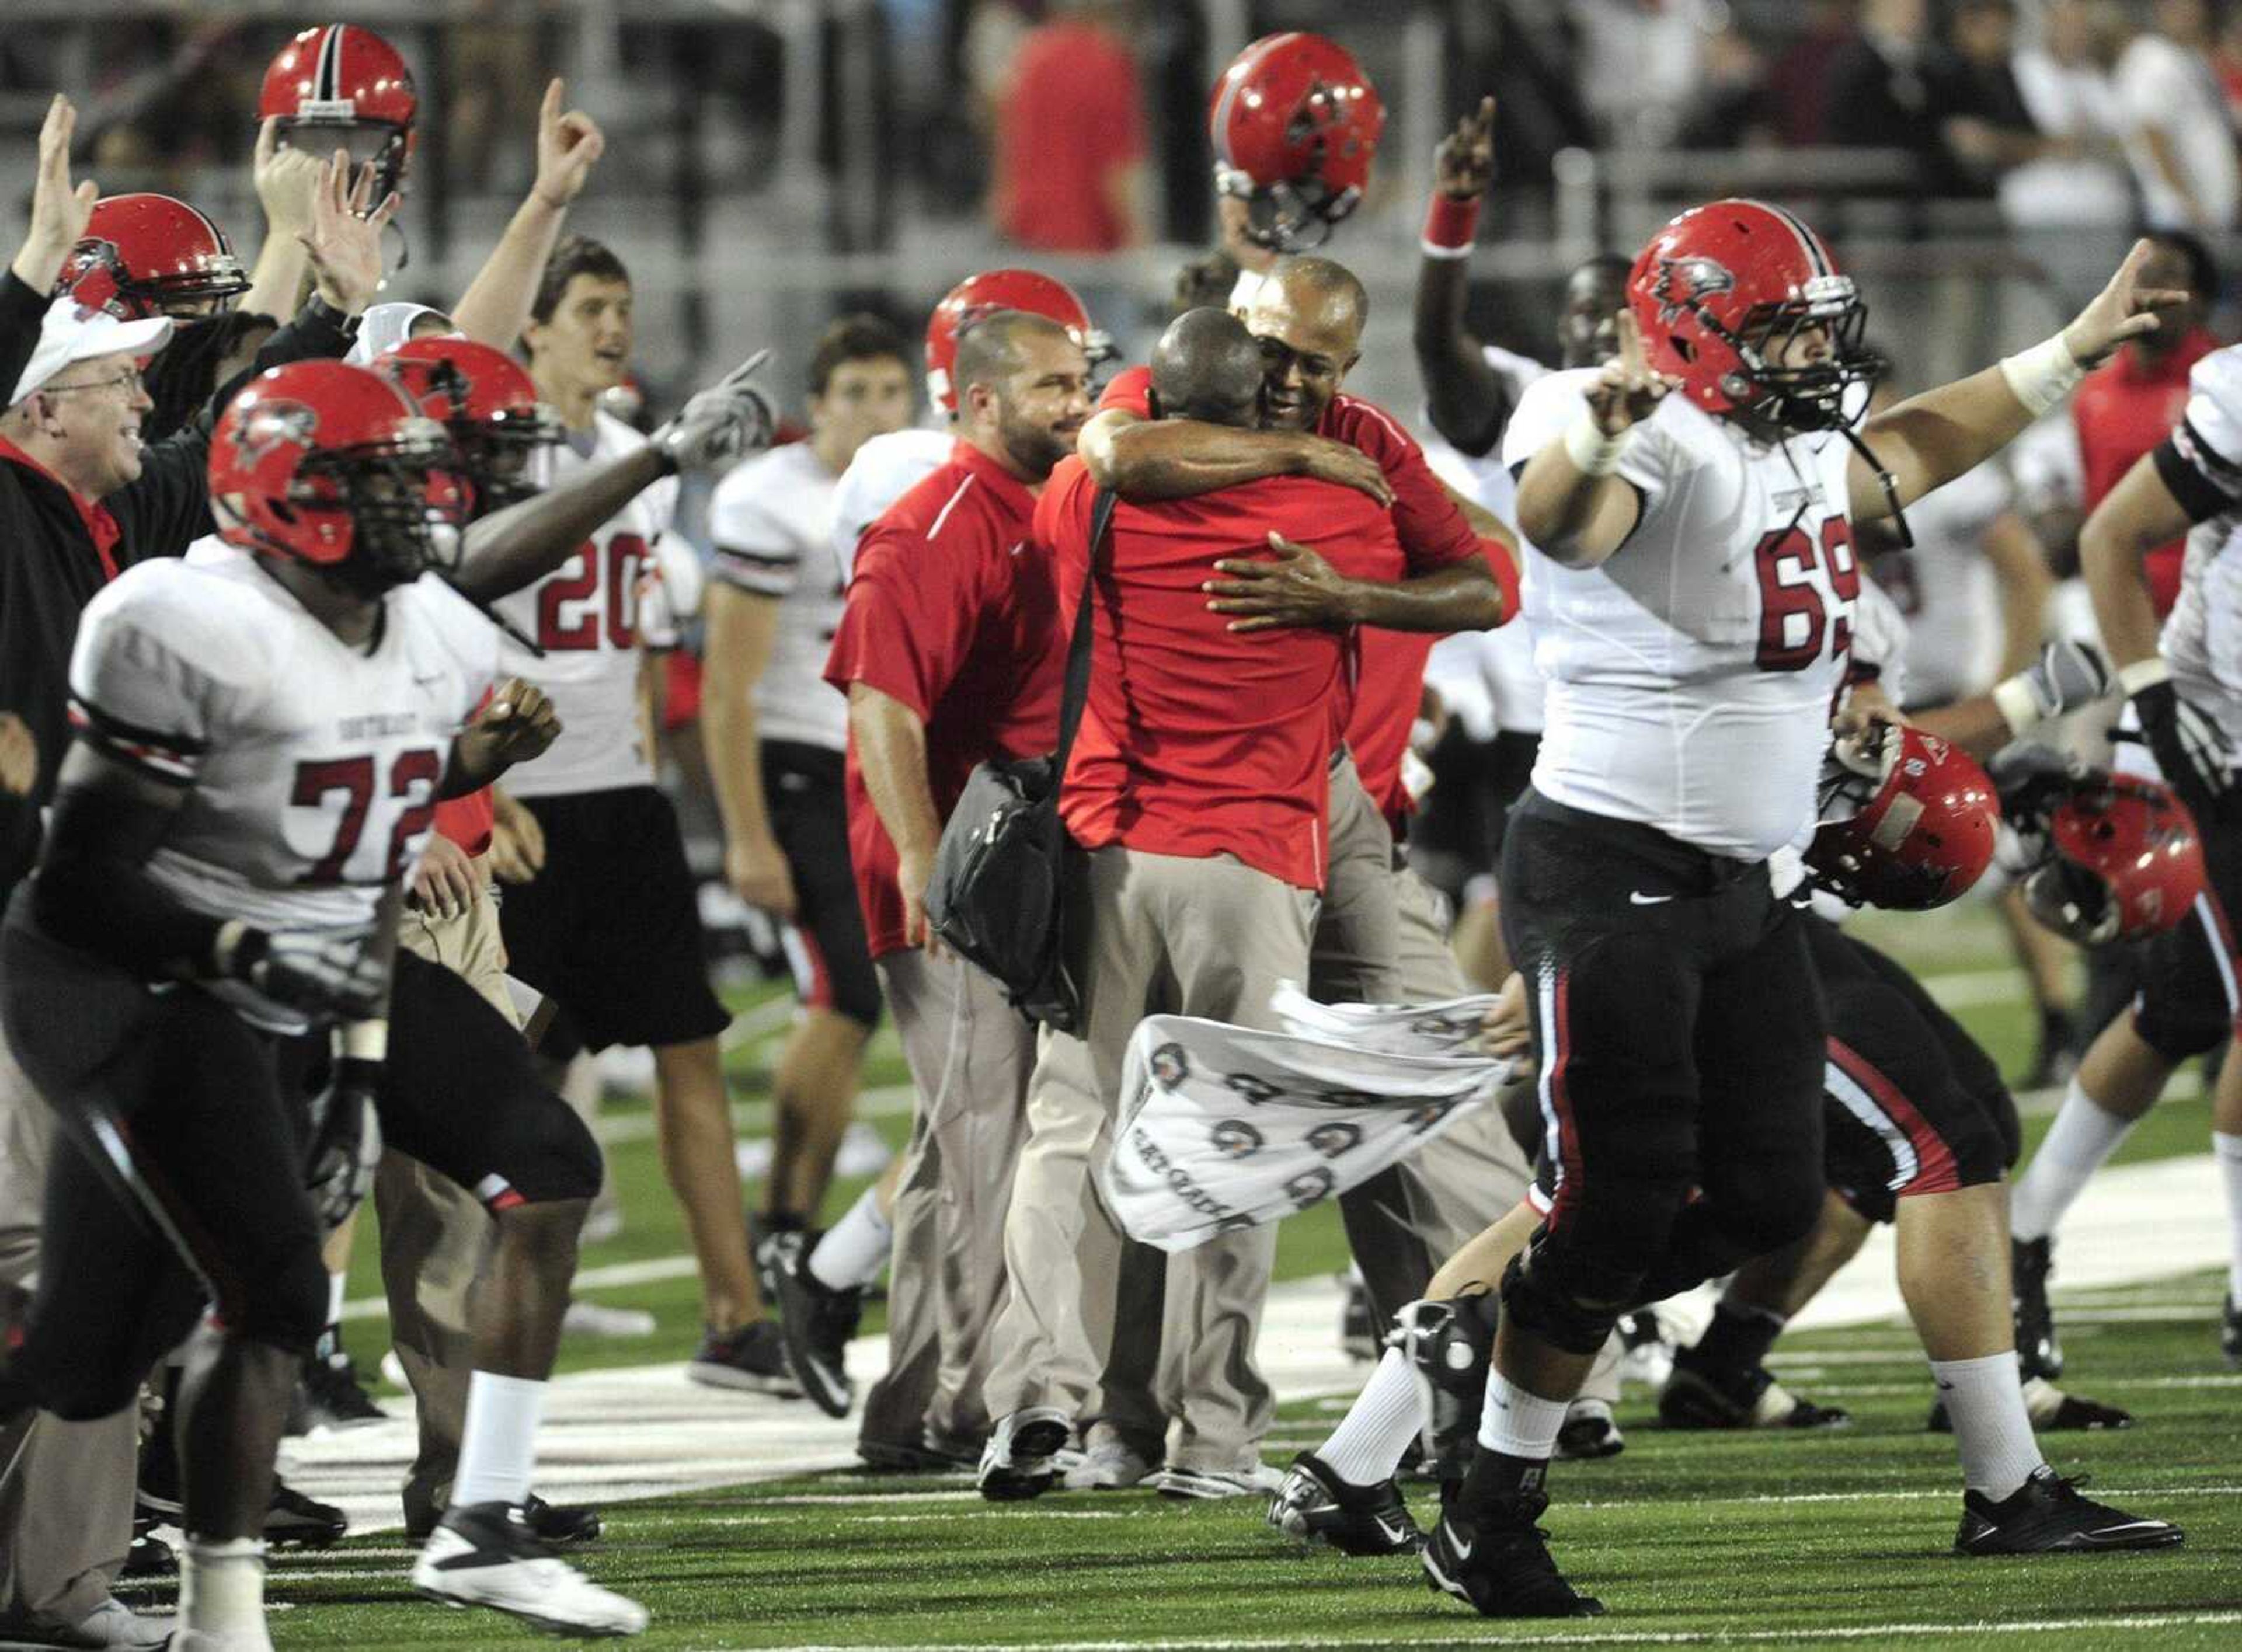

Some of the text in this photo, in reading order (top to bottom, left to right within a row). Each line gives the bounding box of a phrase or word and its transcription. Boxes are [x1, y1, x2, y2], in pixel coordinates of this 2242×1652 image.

[538, 532, 649, 650] 20
[1755, 514, 1861, 671] 69
[290, 749, 441, 883] 72
